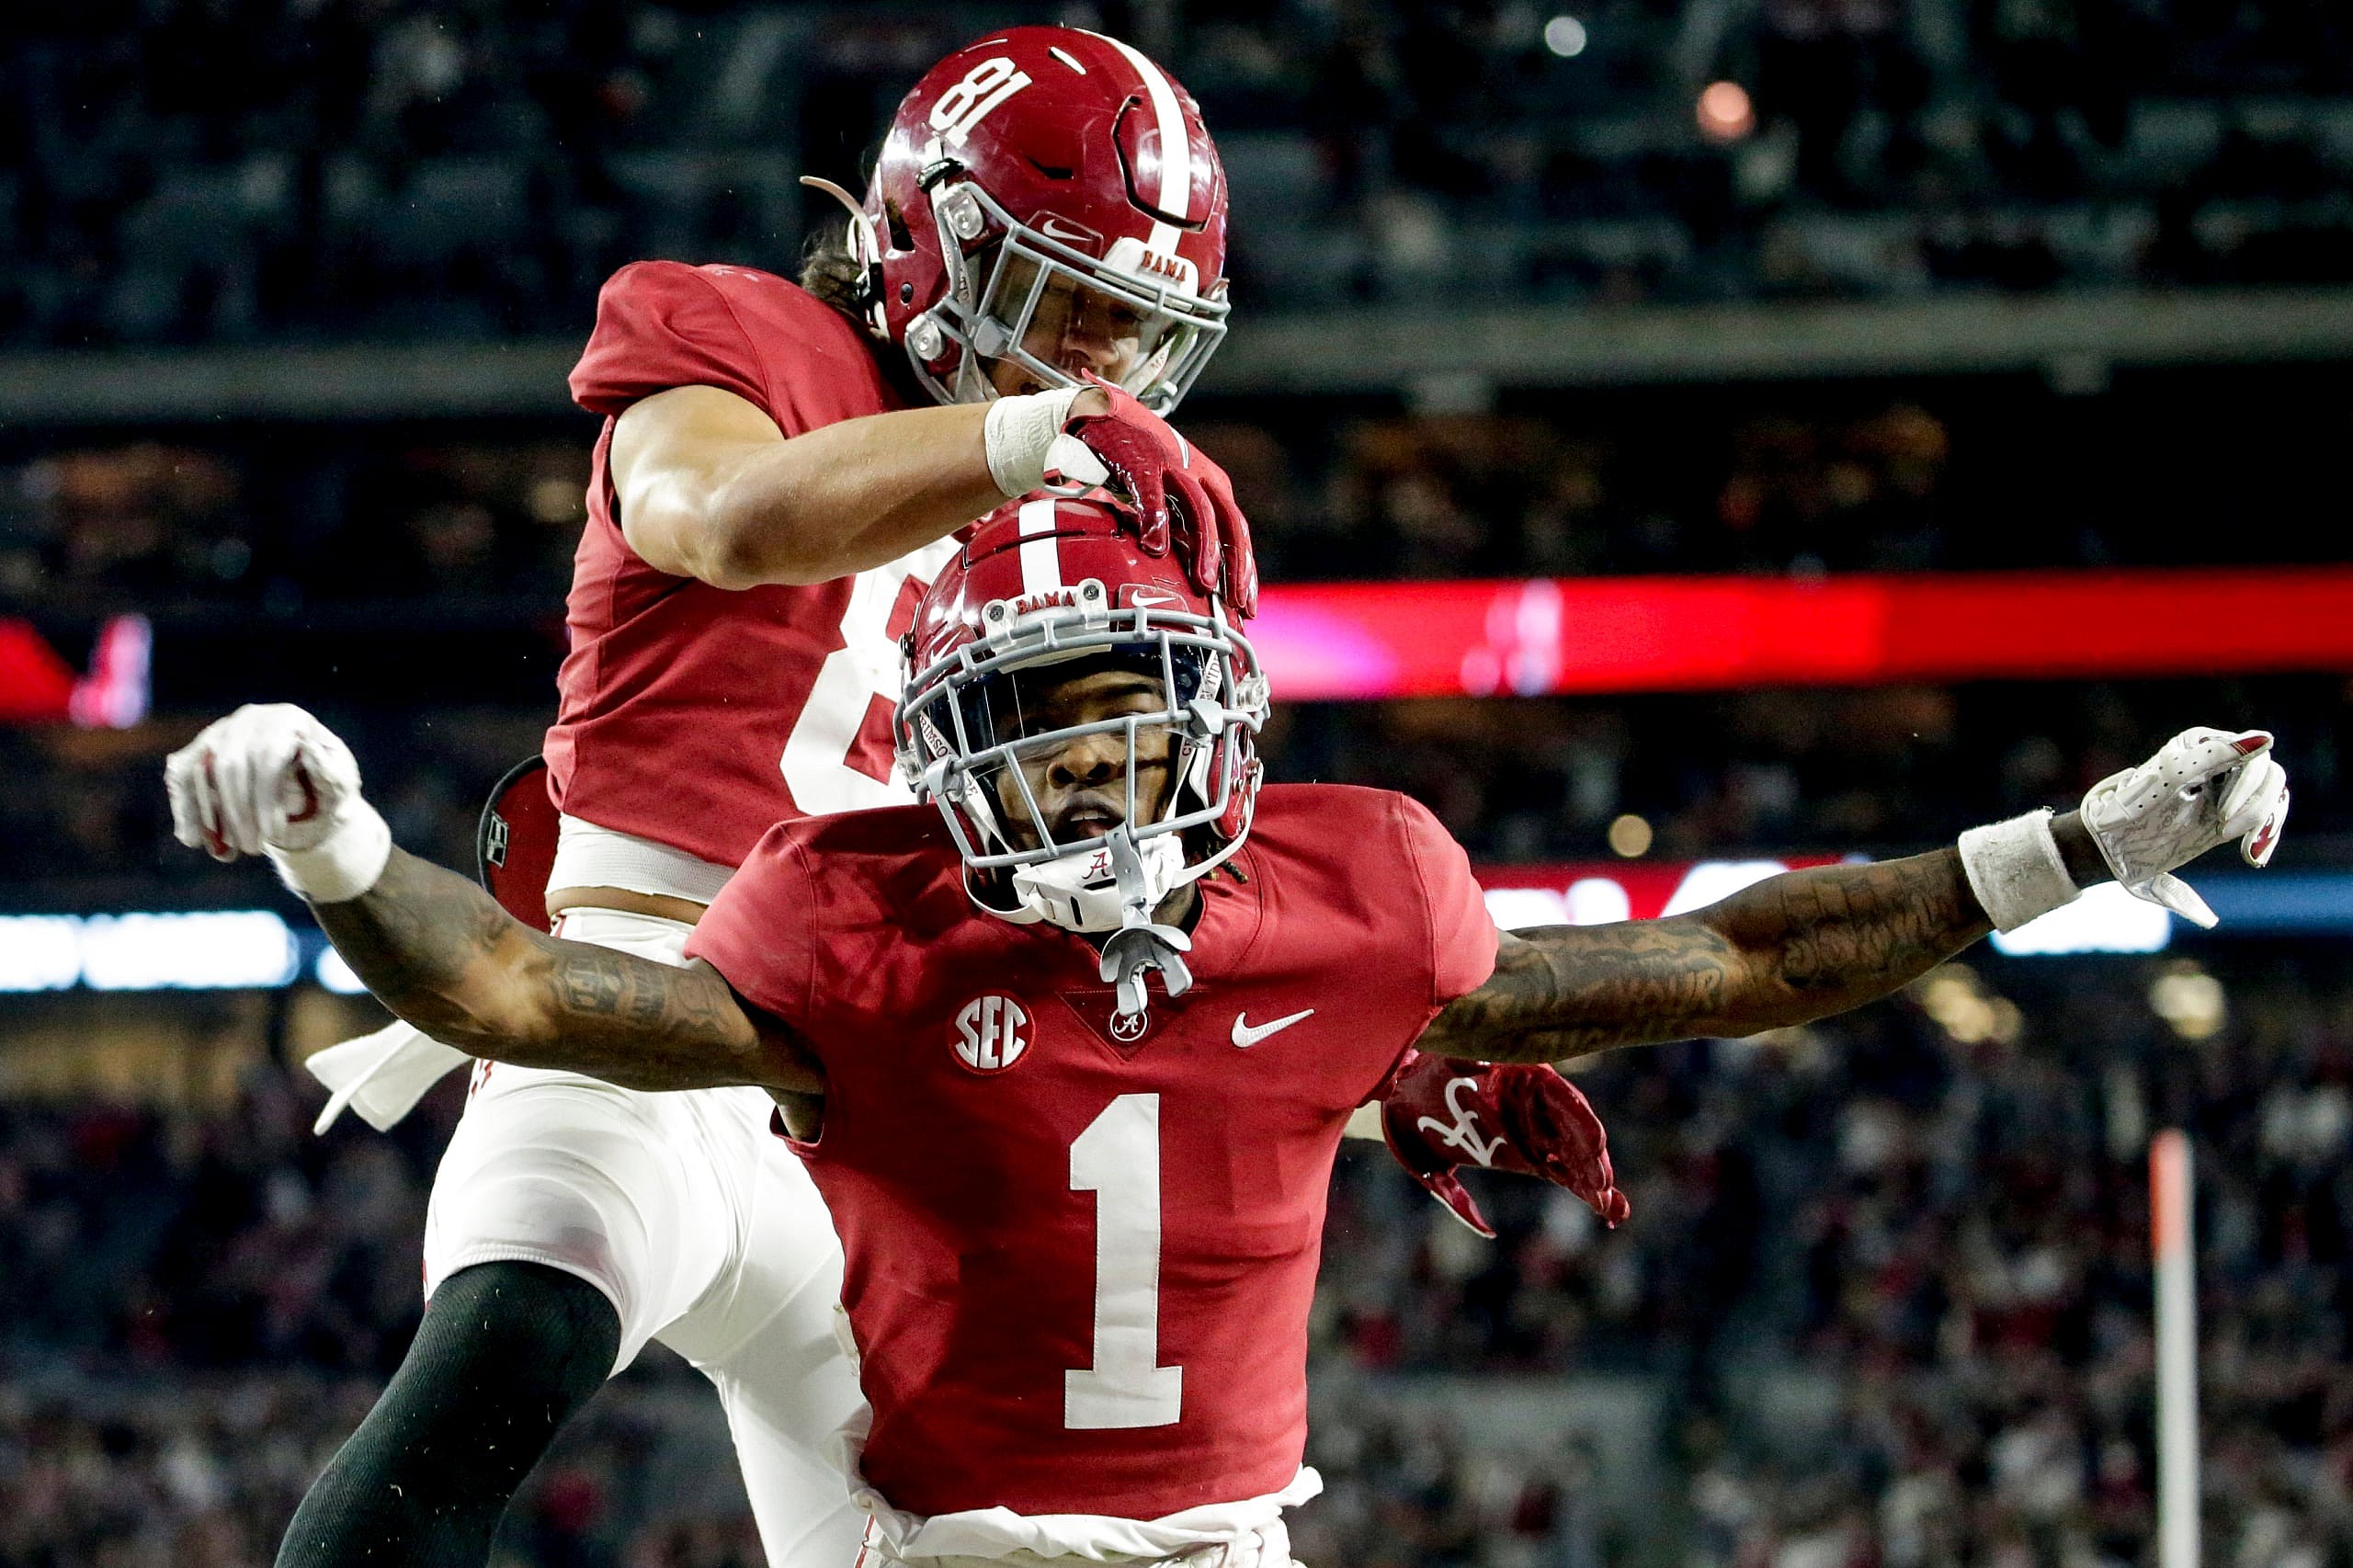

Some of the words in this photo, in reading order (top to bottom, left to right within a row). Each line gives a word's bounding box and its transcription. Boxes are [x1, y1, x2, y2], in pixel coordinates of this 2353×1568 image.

[928, 57, 1033, 149] 81
[1141, 250, 1187, 283] BAMA
[1016, 590, 1076, 616] BAMA
[955, 995, 1028, 1069] SEC
[1064, 1092, 1184, 1429] 1
